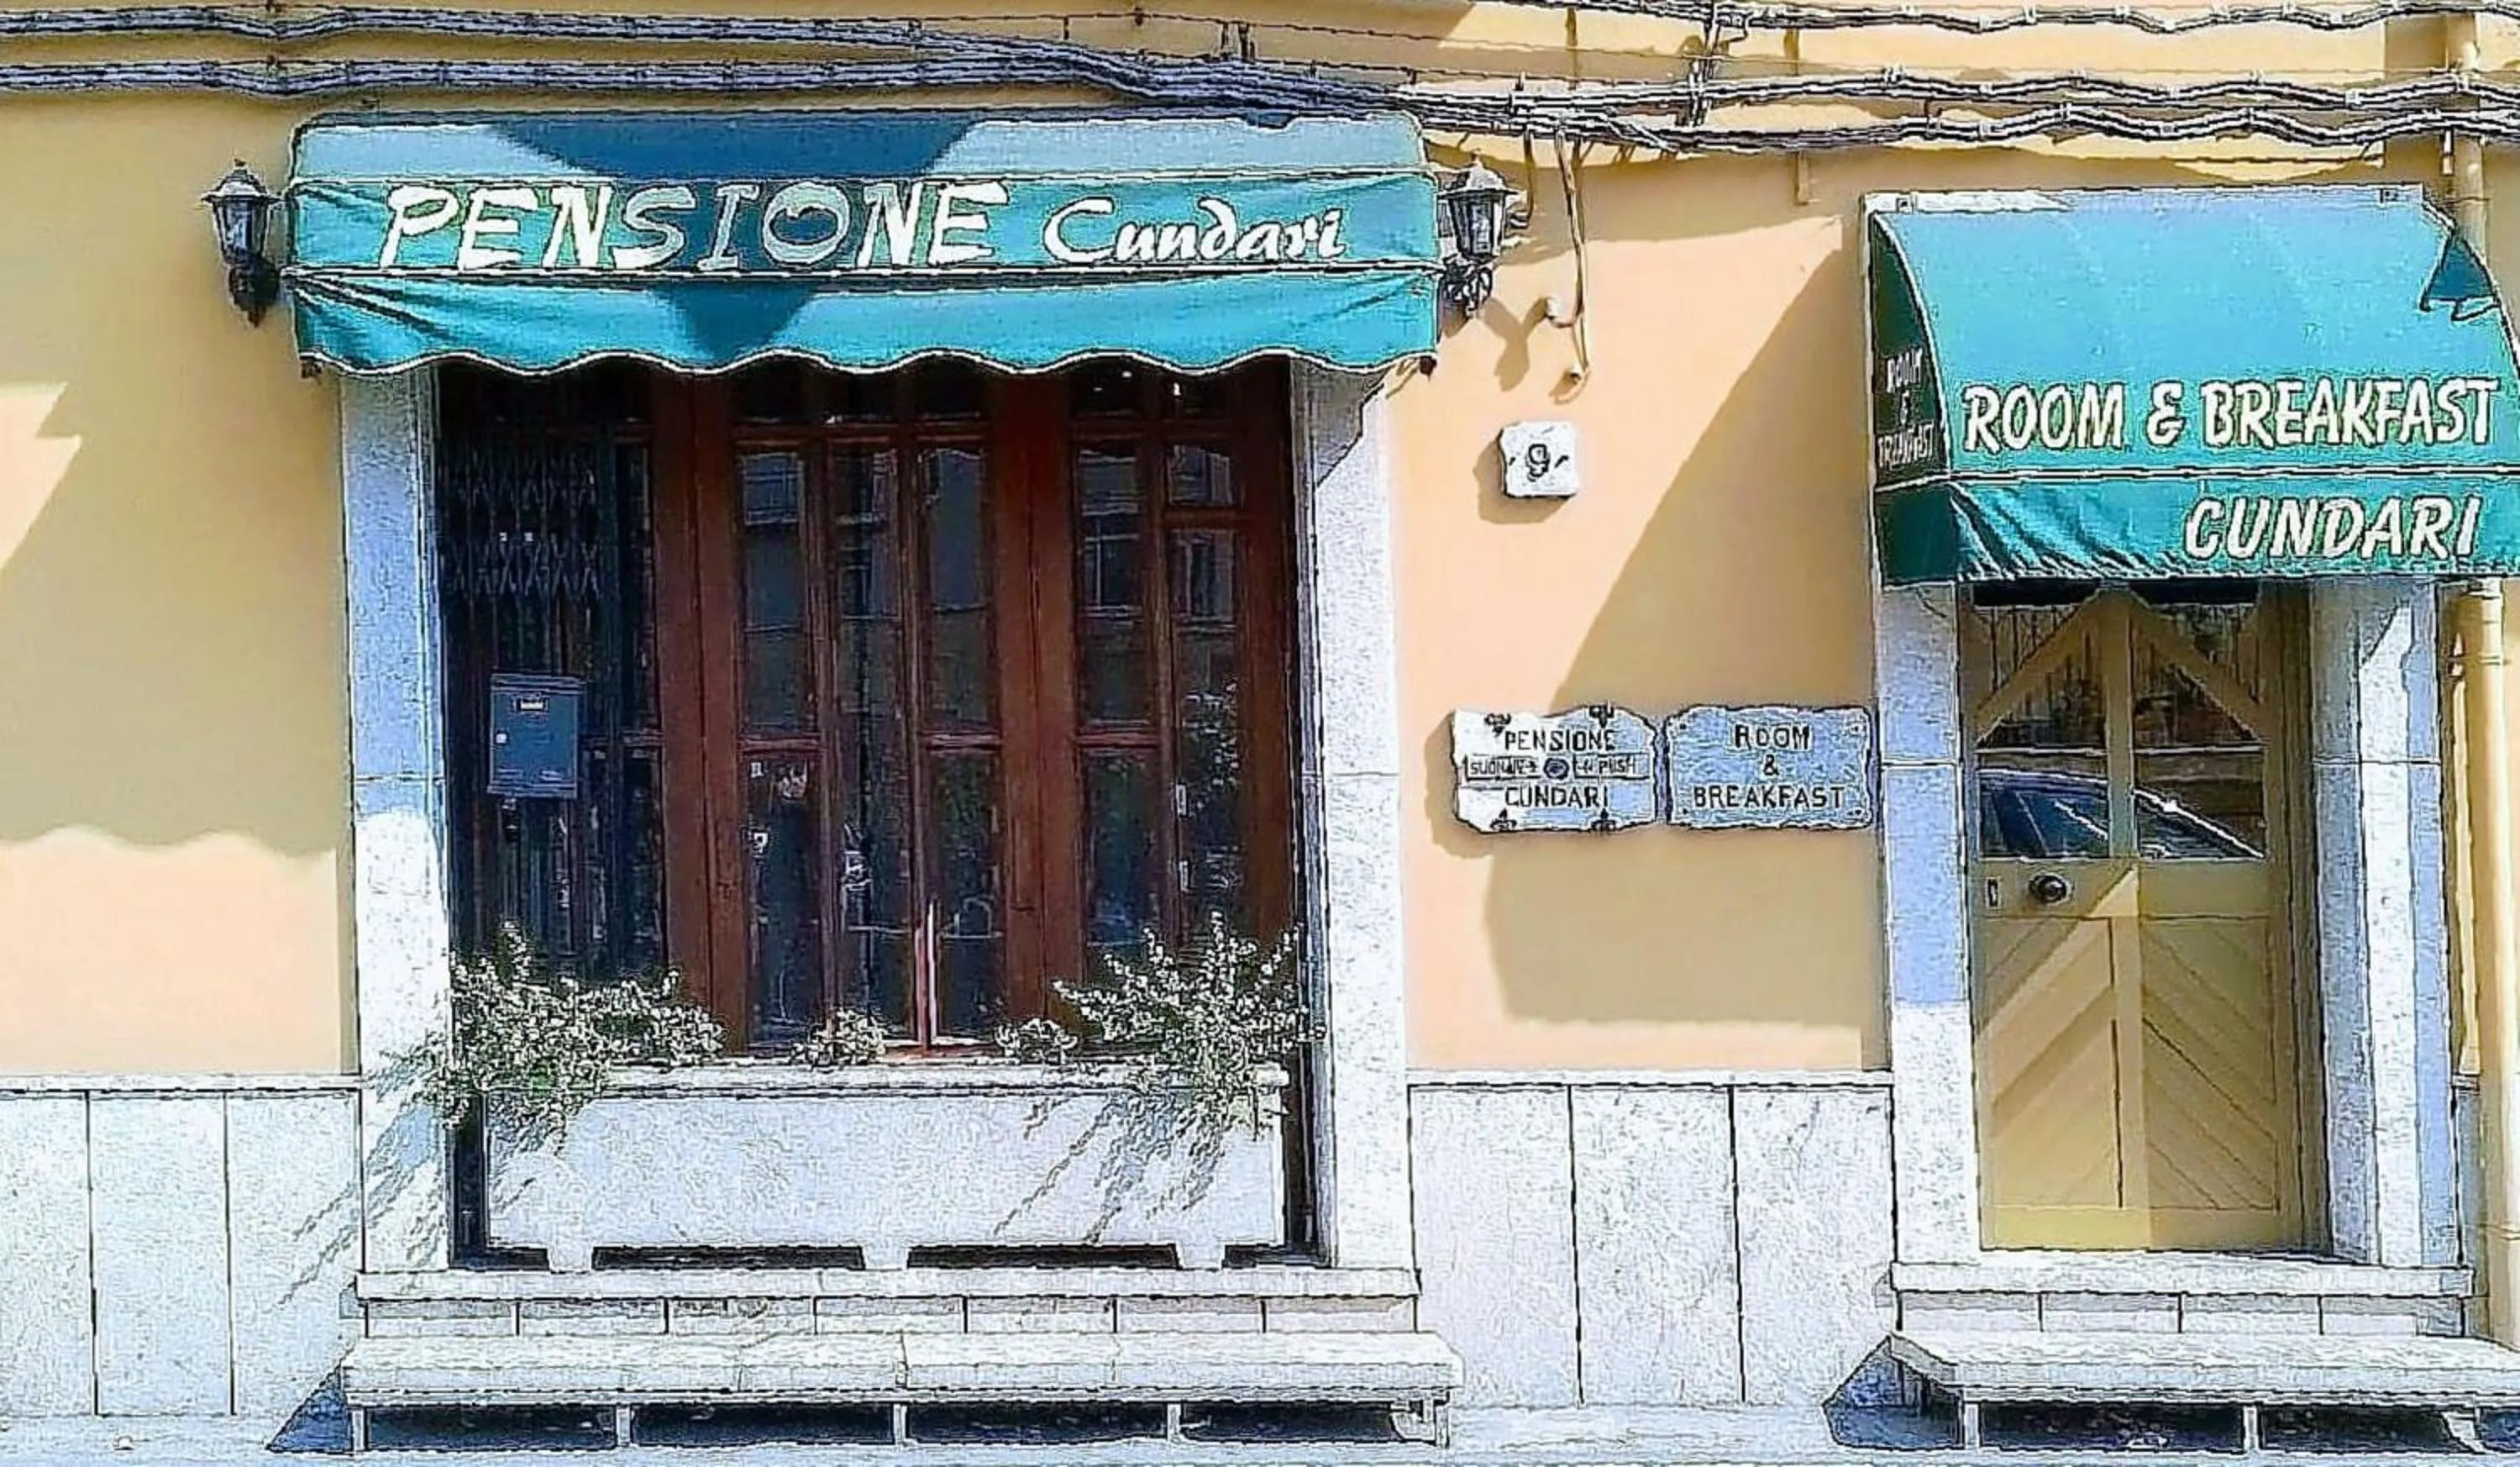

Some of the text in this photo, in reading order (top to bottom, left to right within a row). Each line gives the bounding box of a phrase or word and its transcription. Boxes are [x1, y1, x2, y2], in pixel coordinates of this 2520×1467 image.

[379, 180, 1346, 271] PENSIONE Cundari
[1962, 376, 2498, 454] ROOM & BREAKFAST
[2186, 495, 2480, 560] CUNDARI
[1504, 728, 1617, 751] PENSIONE
[1735, 724, 1810, 749] ROOM
[1764, 755, 1780, 775] &
[1504, 784, 1609, 808] CUNDARI
[1693, 785, 1846, 809] BREAKFAST
